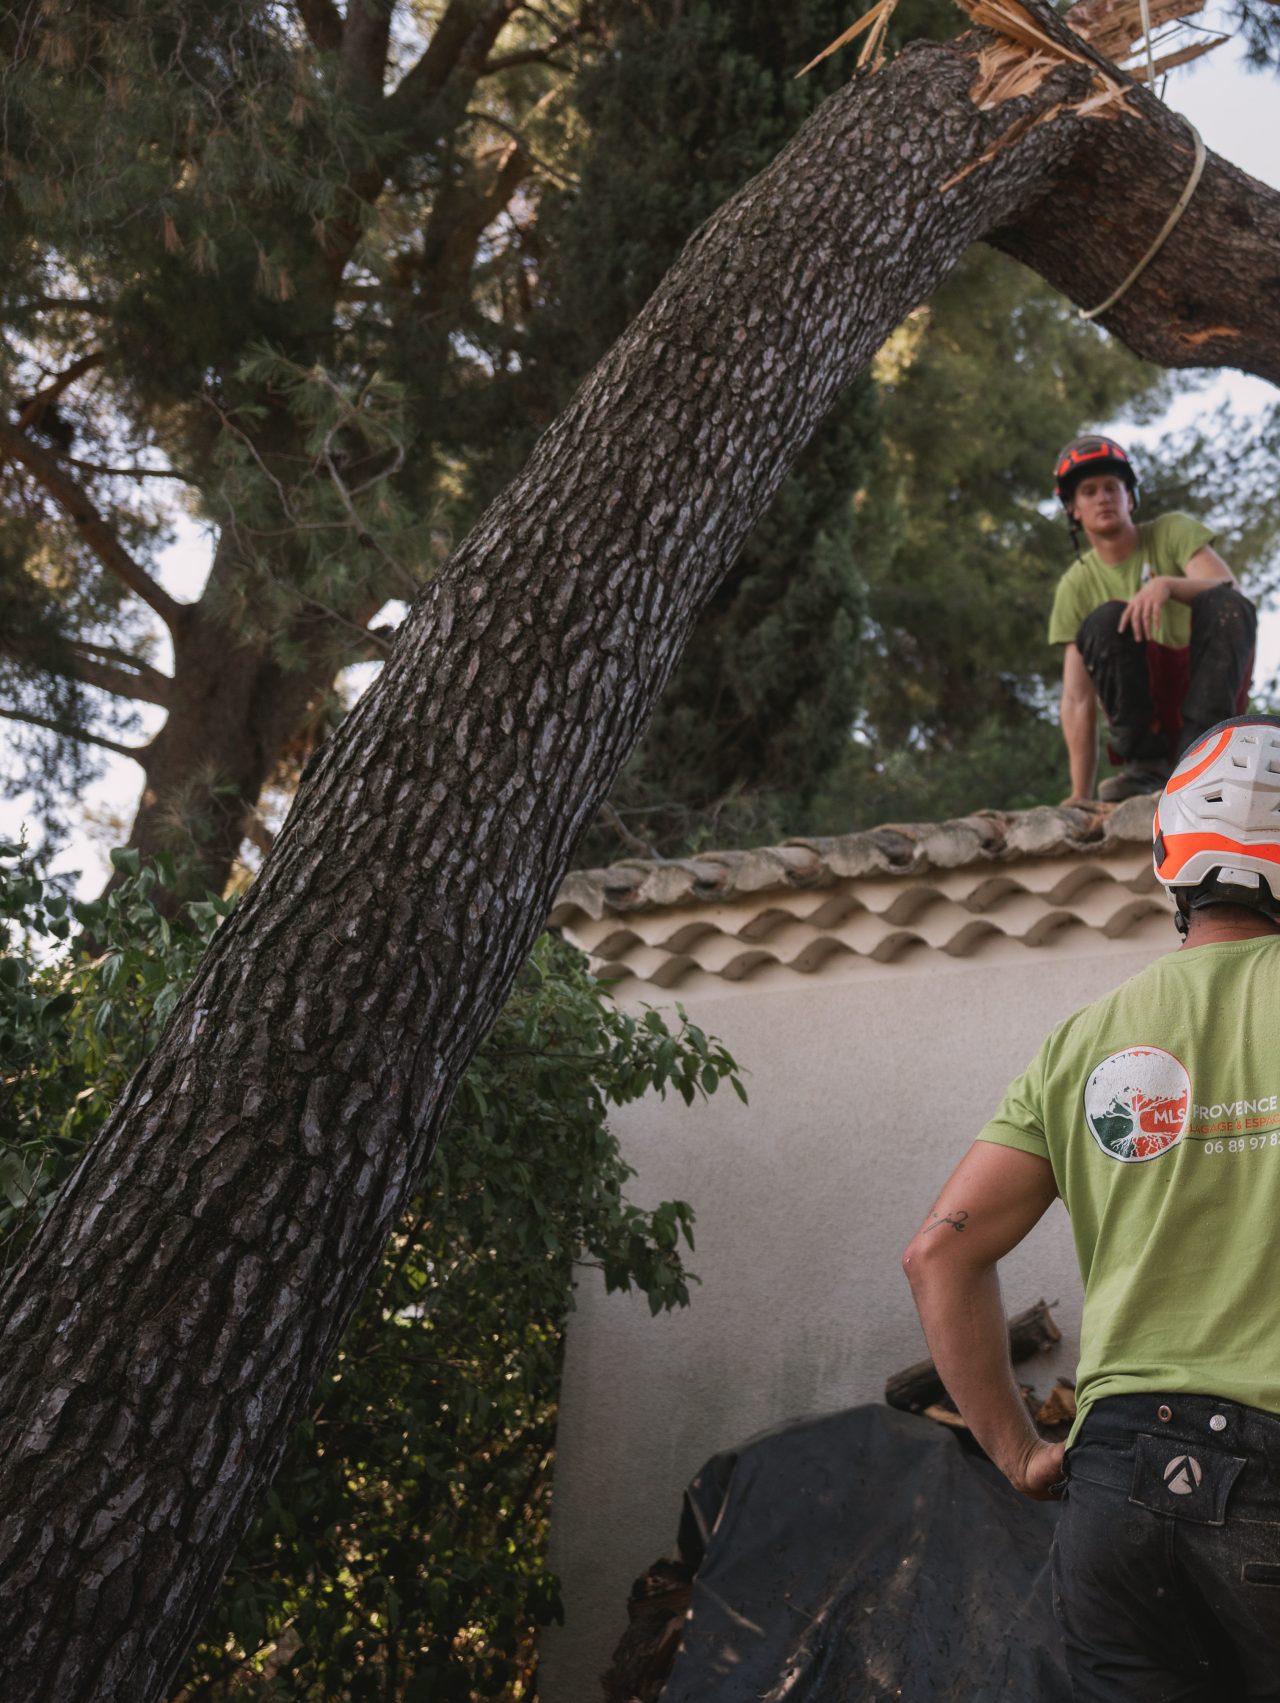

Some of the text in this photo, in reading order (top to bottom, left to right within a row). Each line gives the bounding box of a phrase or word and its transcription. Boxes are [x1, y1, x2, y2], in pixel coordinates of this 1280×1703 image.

[1153, 1096, 1277, 1125] MLS PROVENCE
[1204, 1142, 1224, 1154] 06
[1228, 1139, 1245, 1153] 89
[1250, 1136, 1267, 1150] 97
